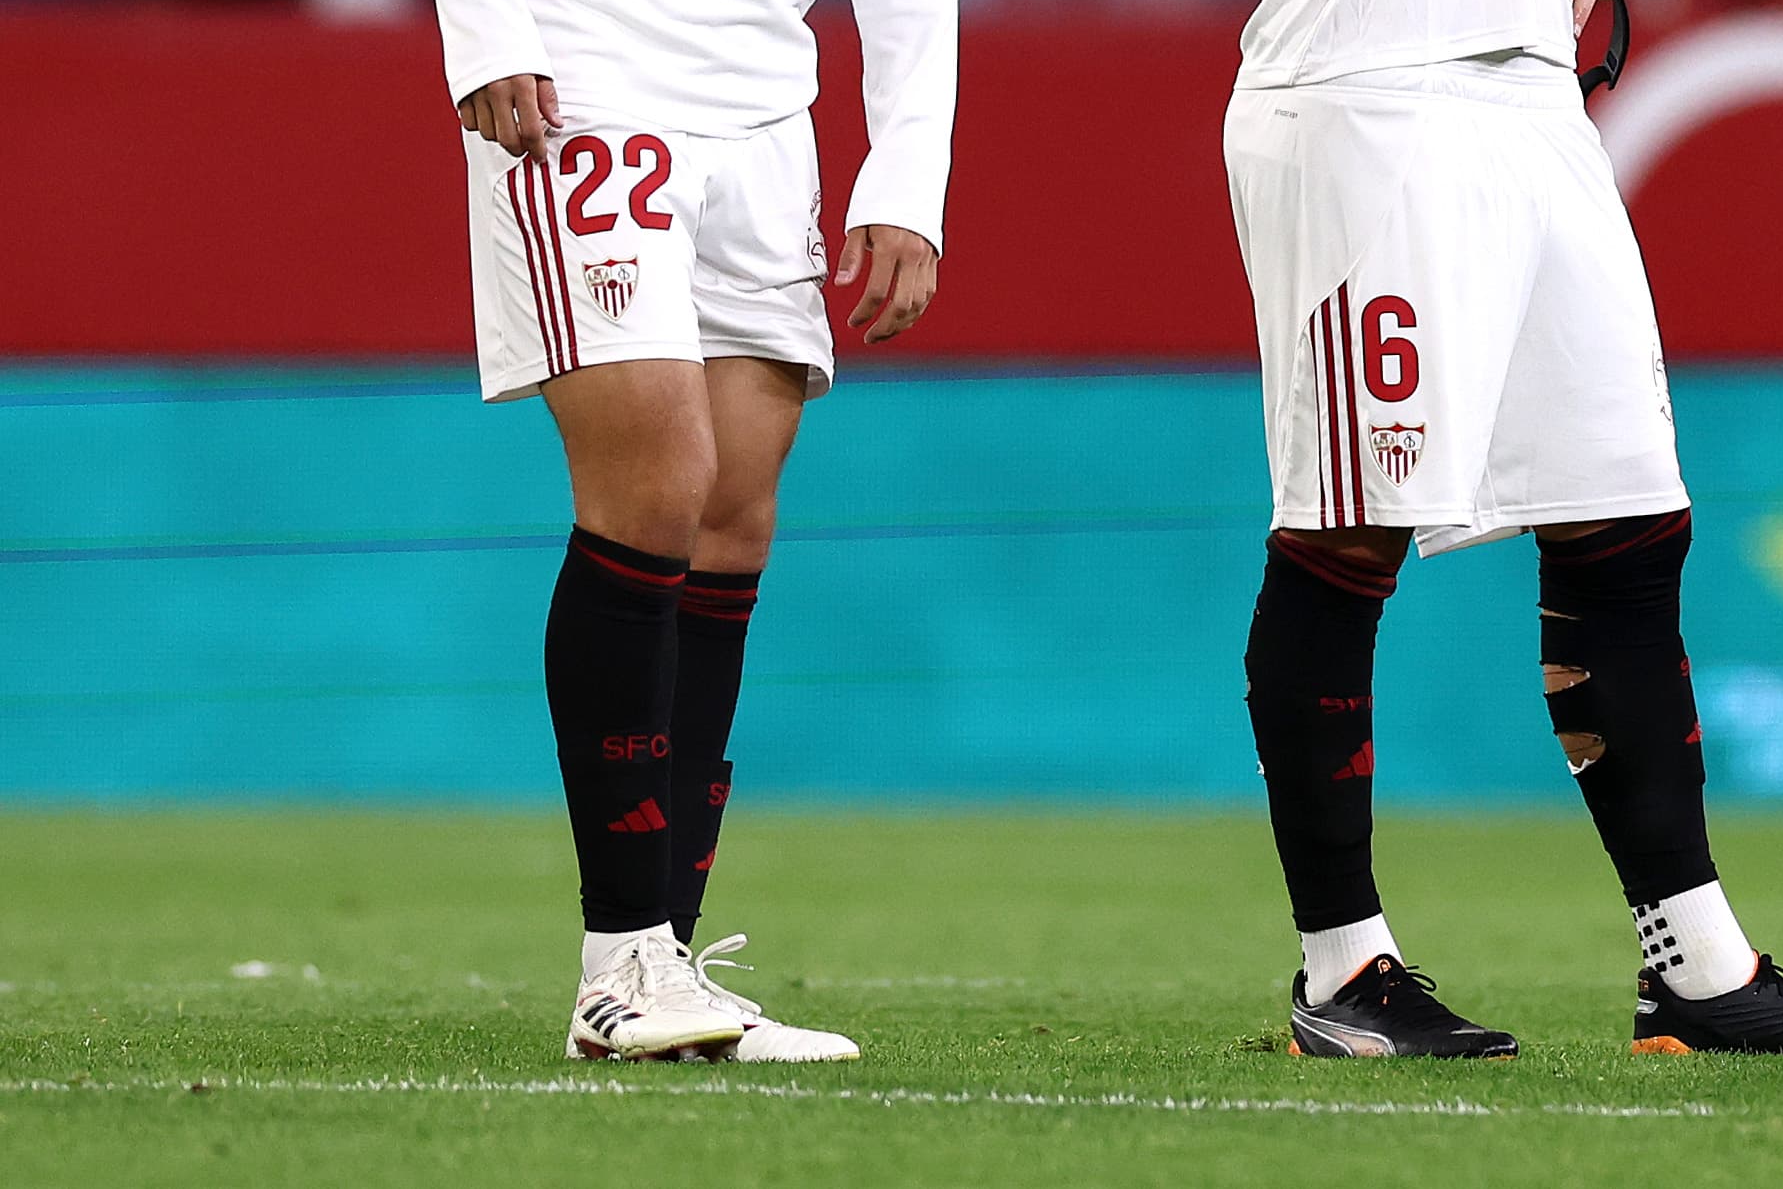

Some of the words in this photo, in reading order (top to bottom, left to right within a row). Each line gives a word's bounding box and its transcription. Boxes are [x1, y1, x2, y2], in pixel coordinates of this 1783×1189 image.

[559, 133, 674, 237] 22
[1360, 294, 1420, 403] 6
[601, 733, 671, 760] SFC
